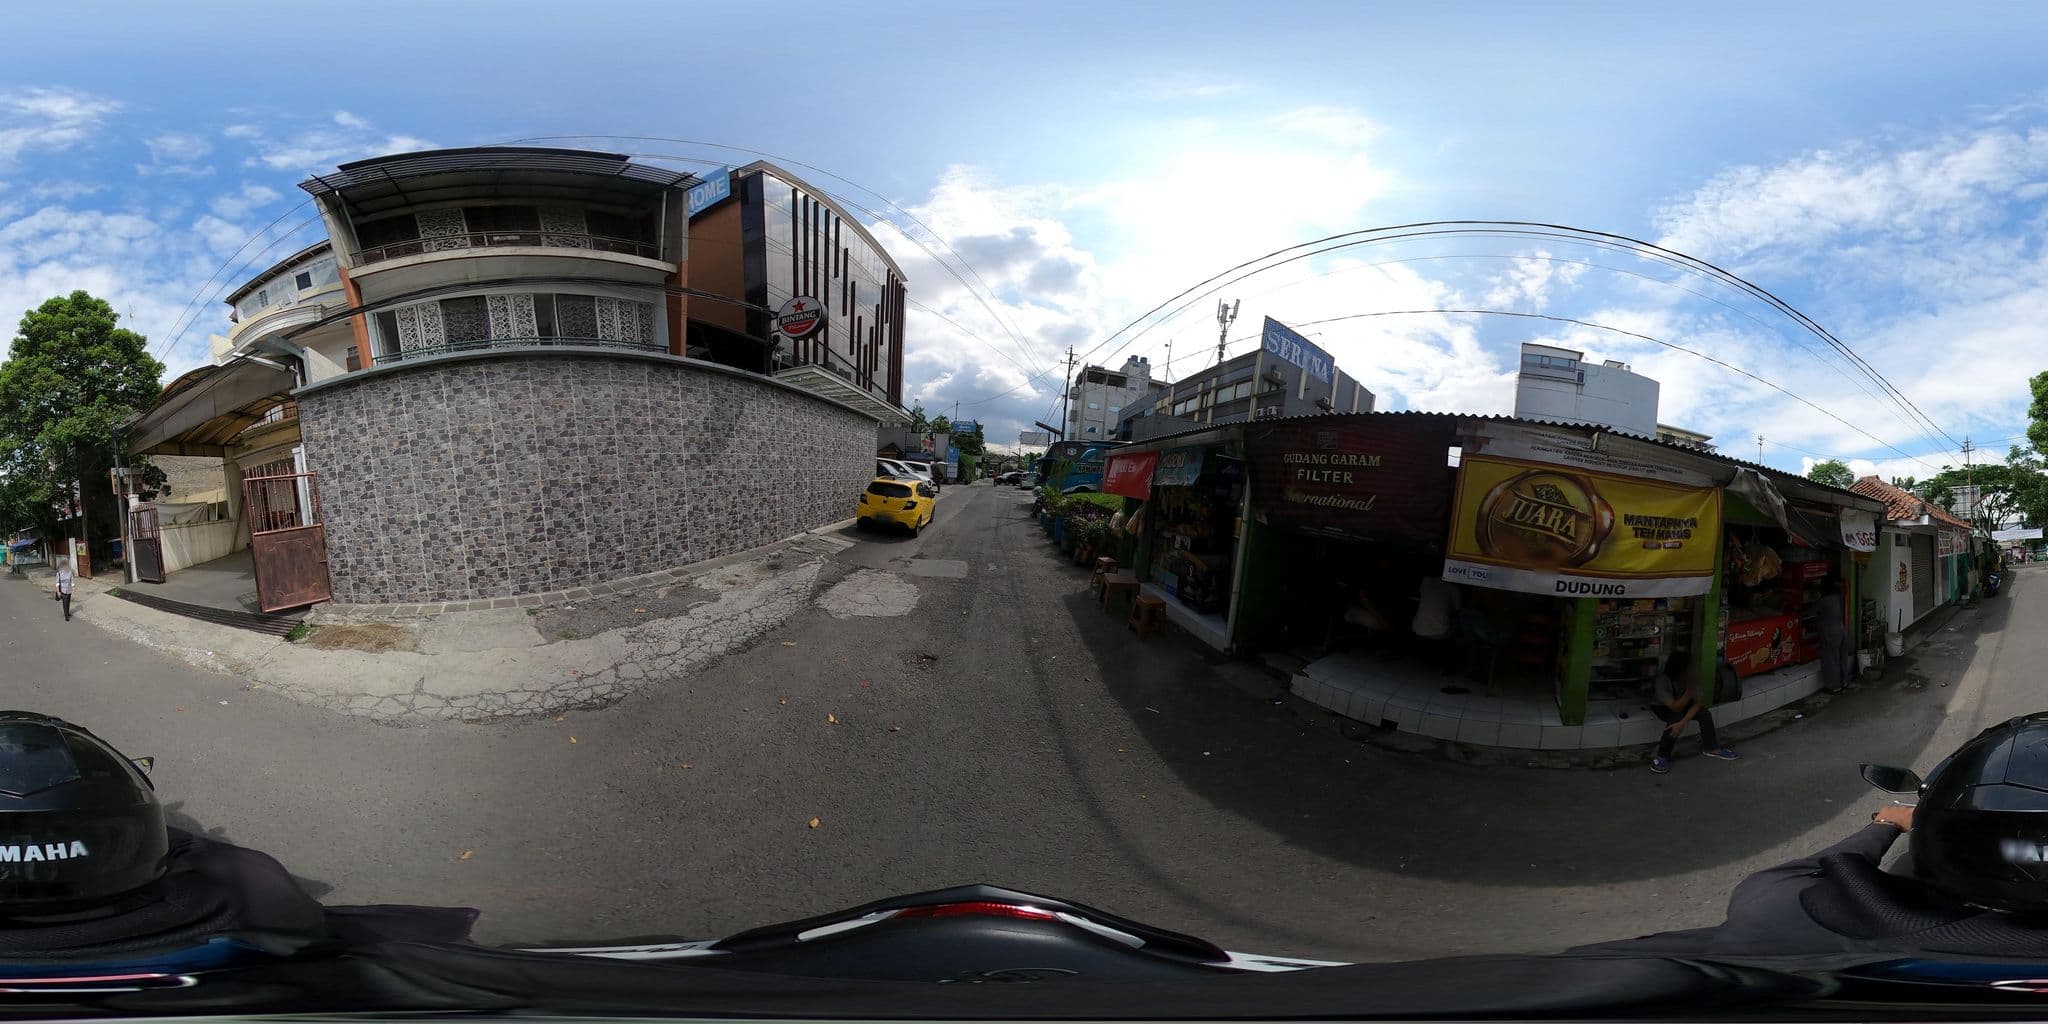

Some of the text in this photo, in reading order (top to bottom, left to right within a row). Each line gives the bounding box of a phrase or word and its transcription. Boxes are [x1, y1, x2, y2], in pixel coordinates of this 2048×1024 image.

[781, 311, 816, 324] BINTANG
[1283, 453, 1382, 466] GUDANG GARAM
[1297, 469, 1353, 484] FILTER
[1285, 488, 1377, 511] nrnational
[1501, 498, 1577, 538] JUARA
[1623, 513, 1697, 528] MANTAPNYA
[1632, 526, 1692, 540] TEH MANIS
[1448, 566, 1467, 576] LOVE
[1555, 580, 1626, 595] DUDUNG
